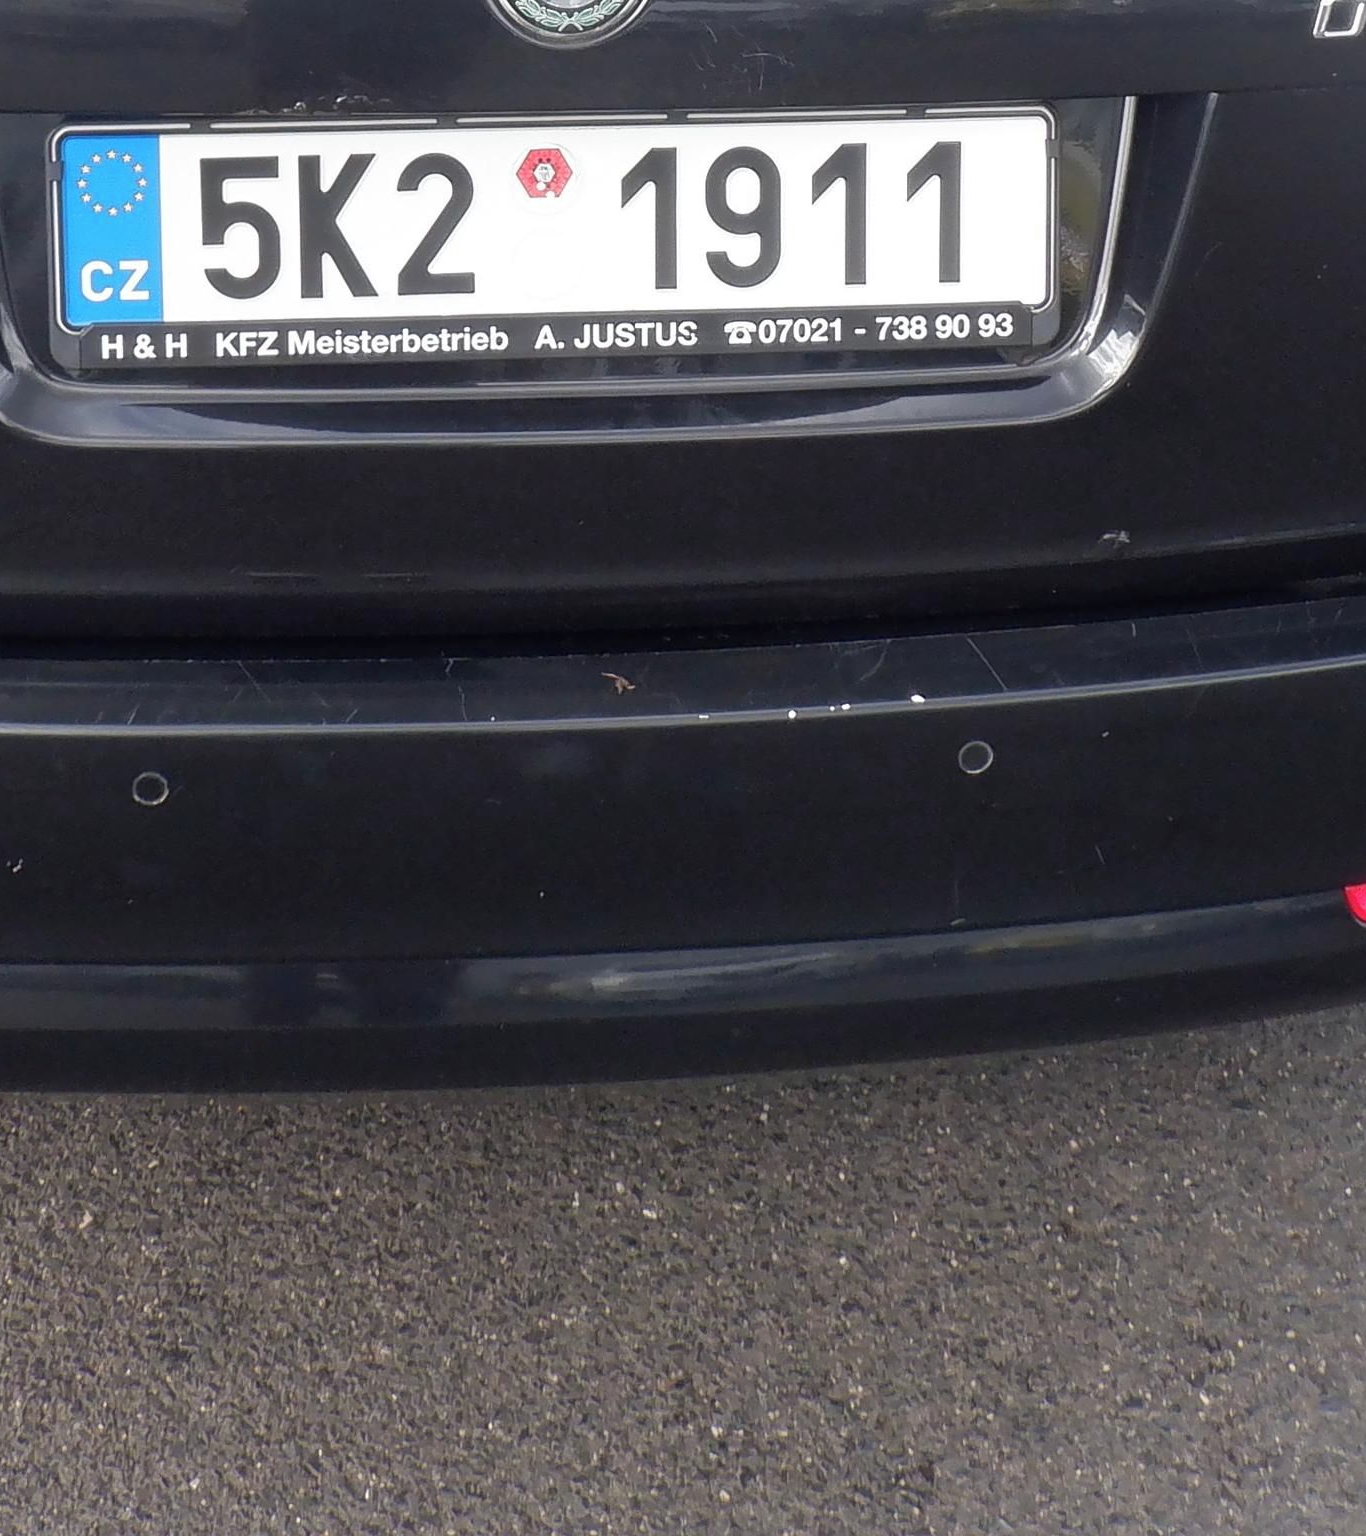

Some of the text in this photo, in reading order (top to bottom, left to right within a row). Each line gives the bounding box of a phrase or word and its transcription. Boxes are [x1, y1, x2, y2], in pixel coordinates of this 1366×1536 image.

[200, 141, 961, 300] 5K2 1911
[81, 260, 150, 302] CZ
[101, 334, 124, 360] H
[133, 333, 157, 360] &
[164, 333, 188, 359] H
[215, 330, 280, 358] KFZ
[287, 325, 509, 356] Meisterbetrieb
[534, 323, 565, 350] A.
[573, 320, 699, 350] JUSTUS
[758, 316, 842, 345] 07021
[875, 315, 928, 341] 738
[934, 313, 971, 340] 90
[977, 312, 1014, 338] 93
